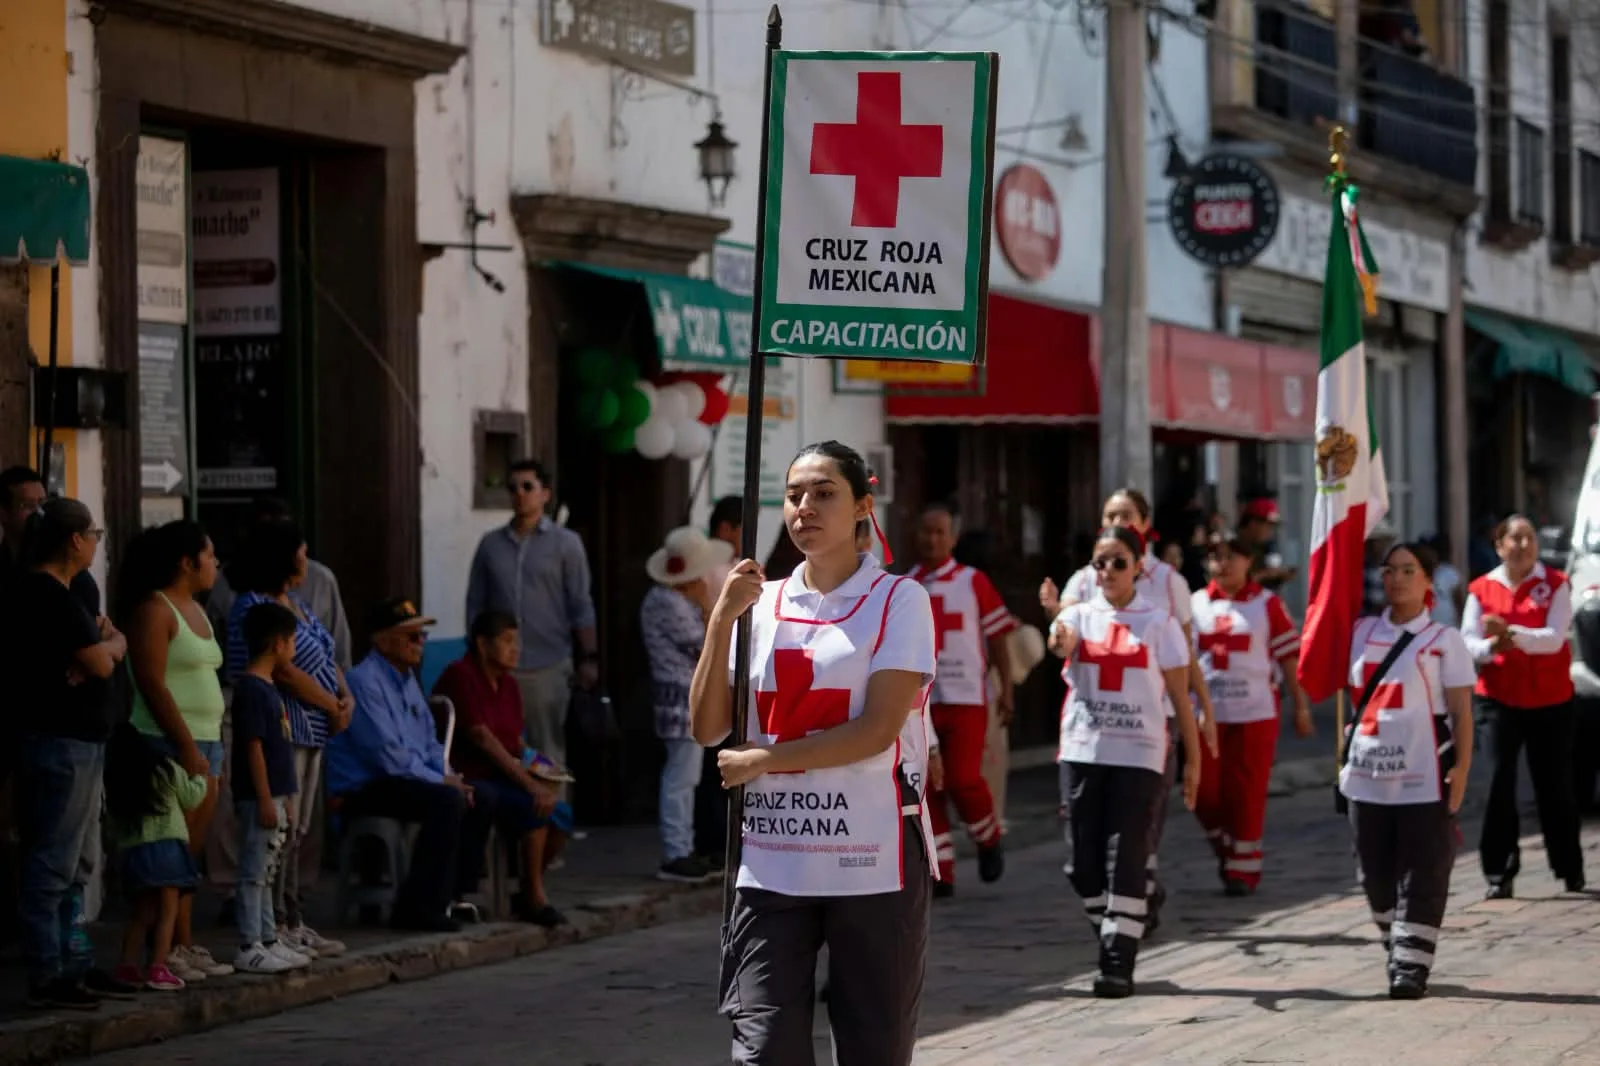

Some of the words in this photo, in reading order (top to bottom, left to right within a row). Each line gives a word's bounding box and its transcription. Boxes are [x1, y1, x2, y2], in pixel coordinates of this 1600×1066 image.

[805, 238, 868, 262] CRUZ
[880, 241, 943, 264] ROJA
[808, 268, 936, 295] MEXICANA
[770, 320, 967, 352] CAPACITACIÓN
[745, 791, 787, 810] CRUZ
[791, 792, 850, 811] ROJA
[743, 816, 850, 836] MEXICANA
